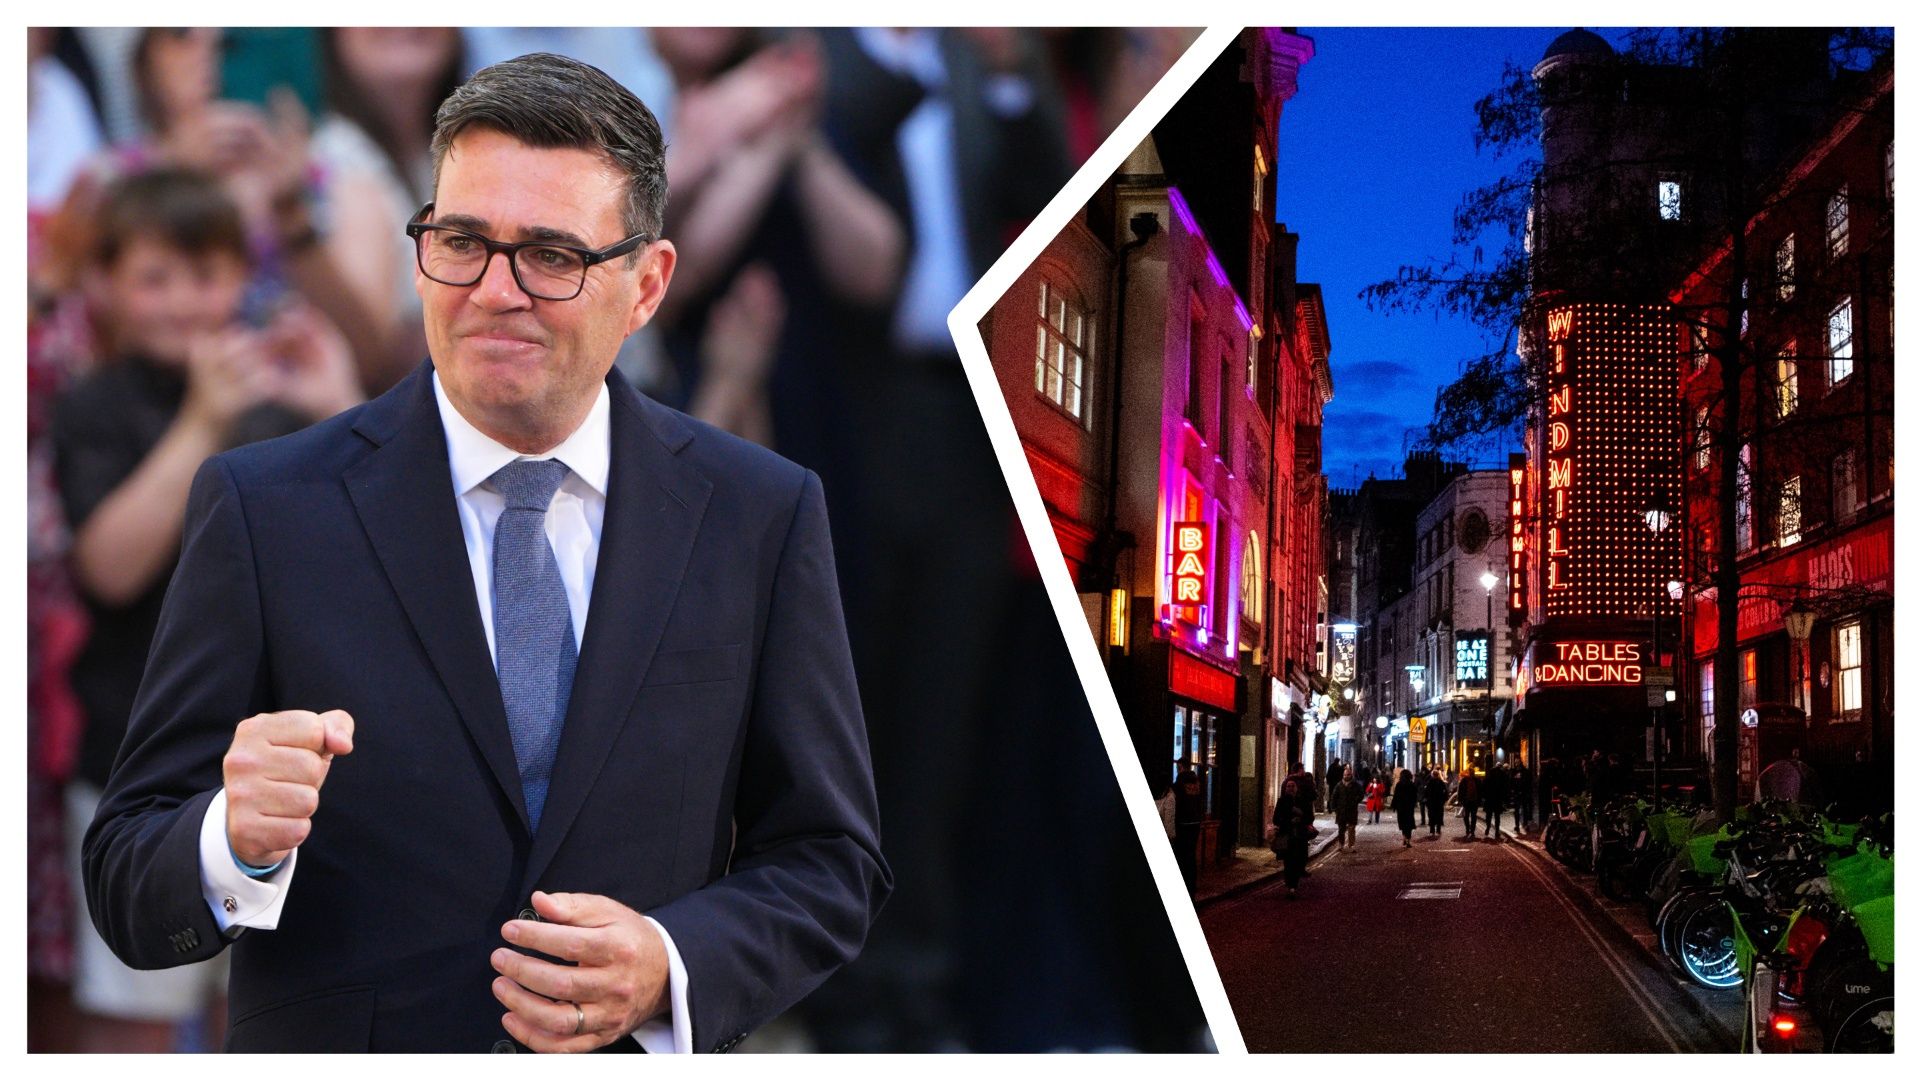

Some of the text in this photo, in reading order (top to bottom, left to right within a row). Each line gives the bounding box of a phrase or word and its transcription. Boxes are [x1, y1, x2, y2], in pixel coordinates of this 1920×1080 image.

[1548, 310, 1573, 590] WINDMILL
[1511, 469, 1523, 609] WINDMILL
[1176, 527, 1204, 601] BAR
[1456, 649, 1487, 661] ONE
[1456, 667, 1487, 680] BAR
[1556, 643, 1640, 662] TABLES
